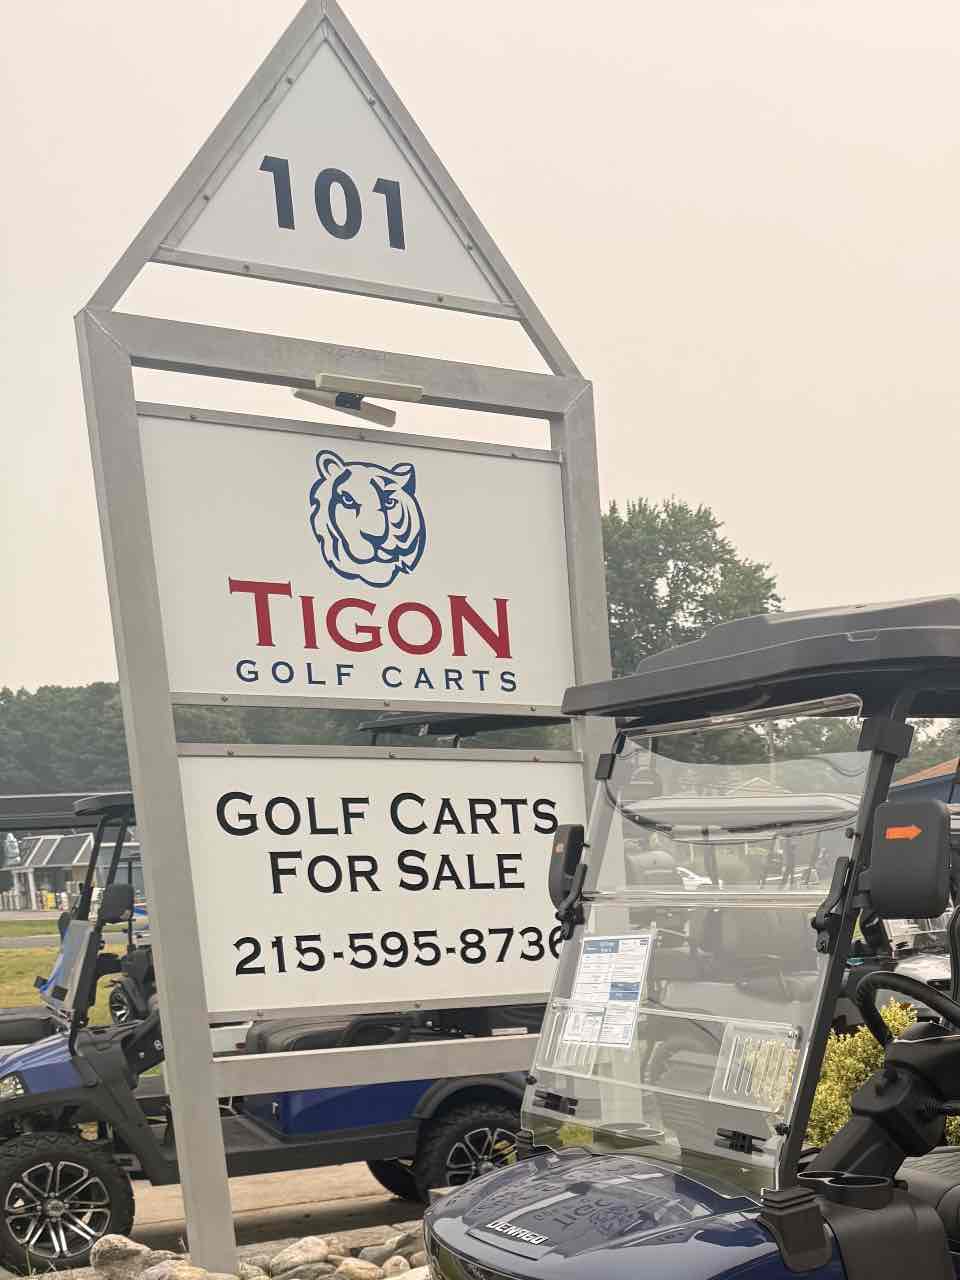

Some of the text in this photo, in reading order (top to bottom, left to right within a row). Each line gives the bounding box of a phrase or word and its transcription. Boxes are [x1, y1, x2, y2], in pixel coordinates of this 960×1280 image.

[259, 155, 406, 251] 101
[228, 578, 512, 659] TIGON
[235, 659, 517, 693] GOLF CARTS
[216, 791, 559, 837] GOLF CARTS
[268, 849, 525, 894] FOR SALE
